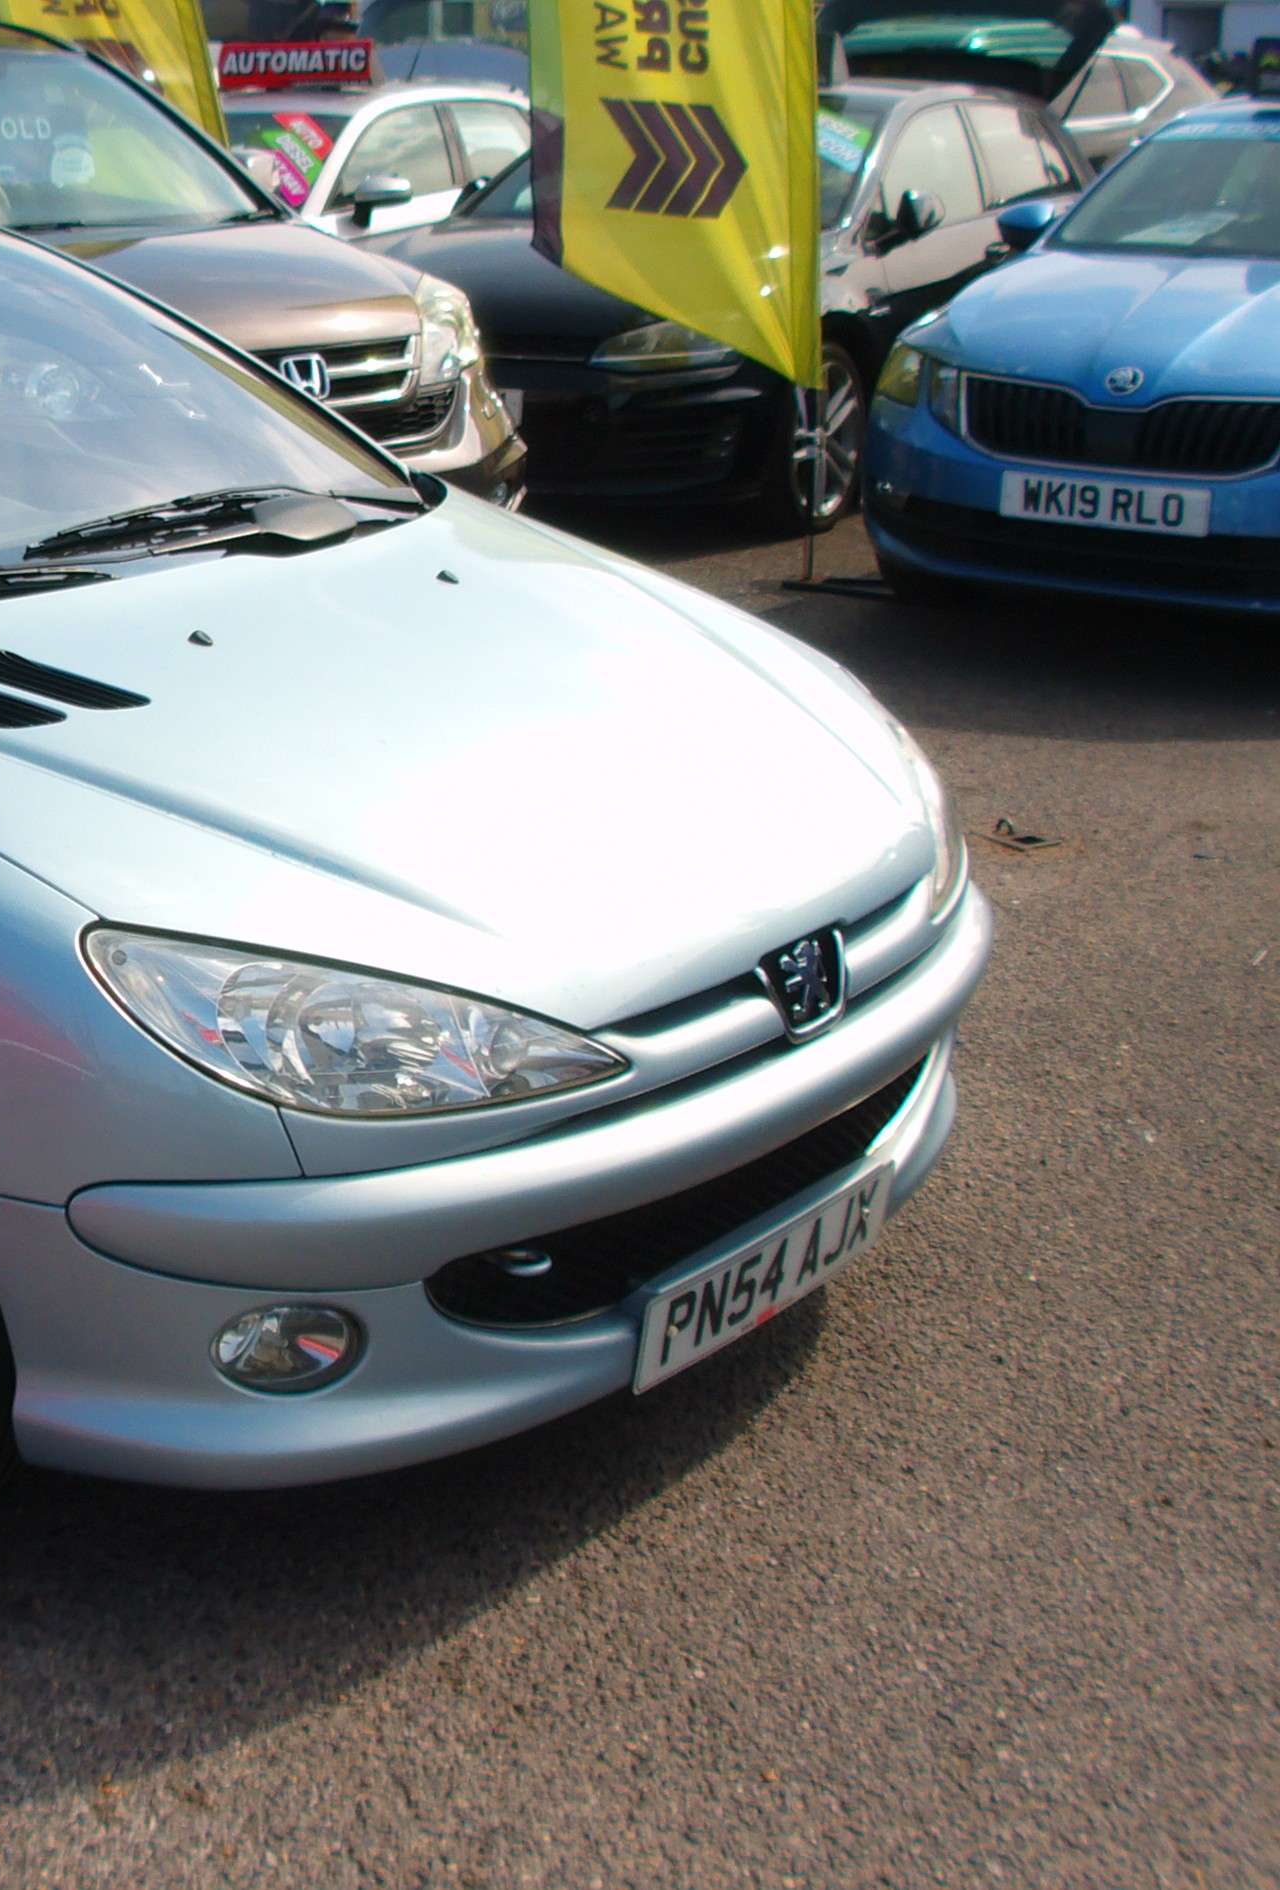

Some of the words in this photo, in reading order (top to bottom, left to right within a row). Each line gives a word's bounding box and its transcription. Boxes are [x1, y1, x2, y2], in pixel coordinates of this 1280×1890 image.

[222, 47, 367, 75] AUTOMATIC
[1023, 478, 1101, 520] WK19
[1111, 487, 1185, 528] RLO
[660, 1237, 788, 1367] PN54
